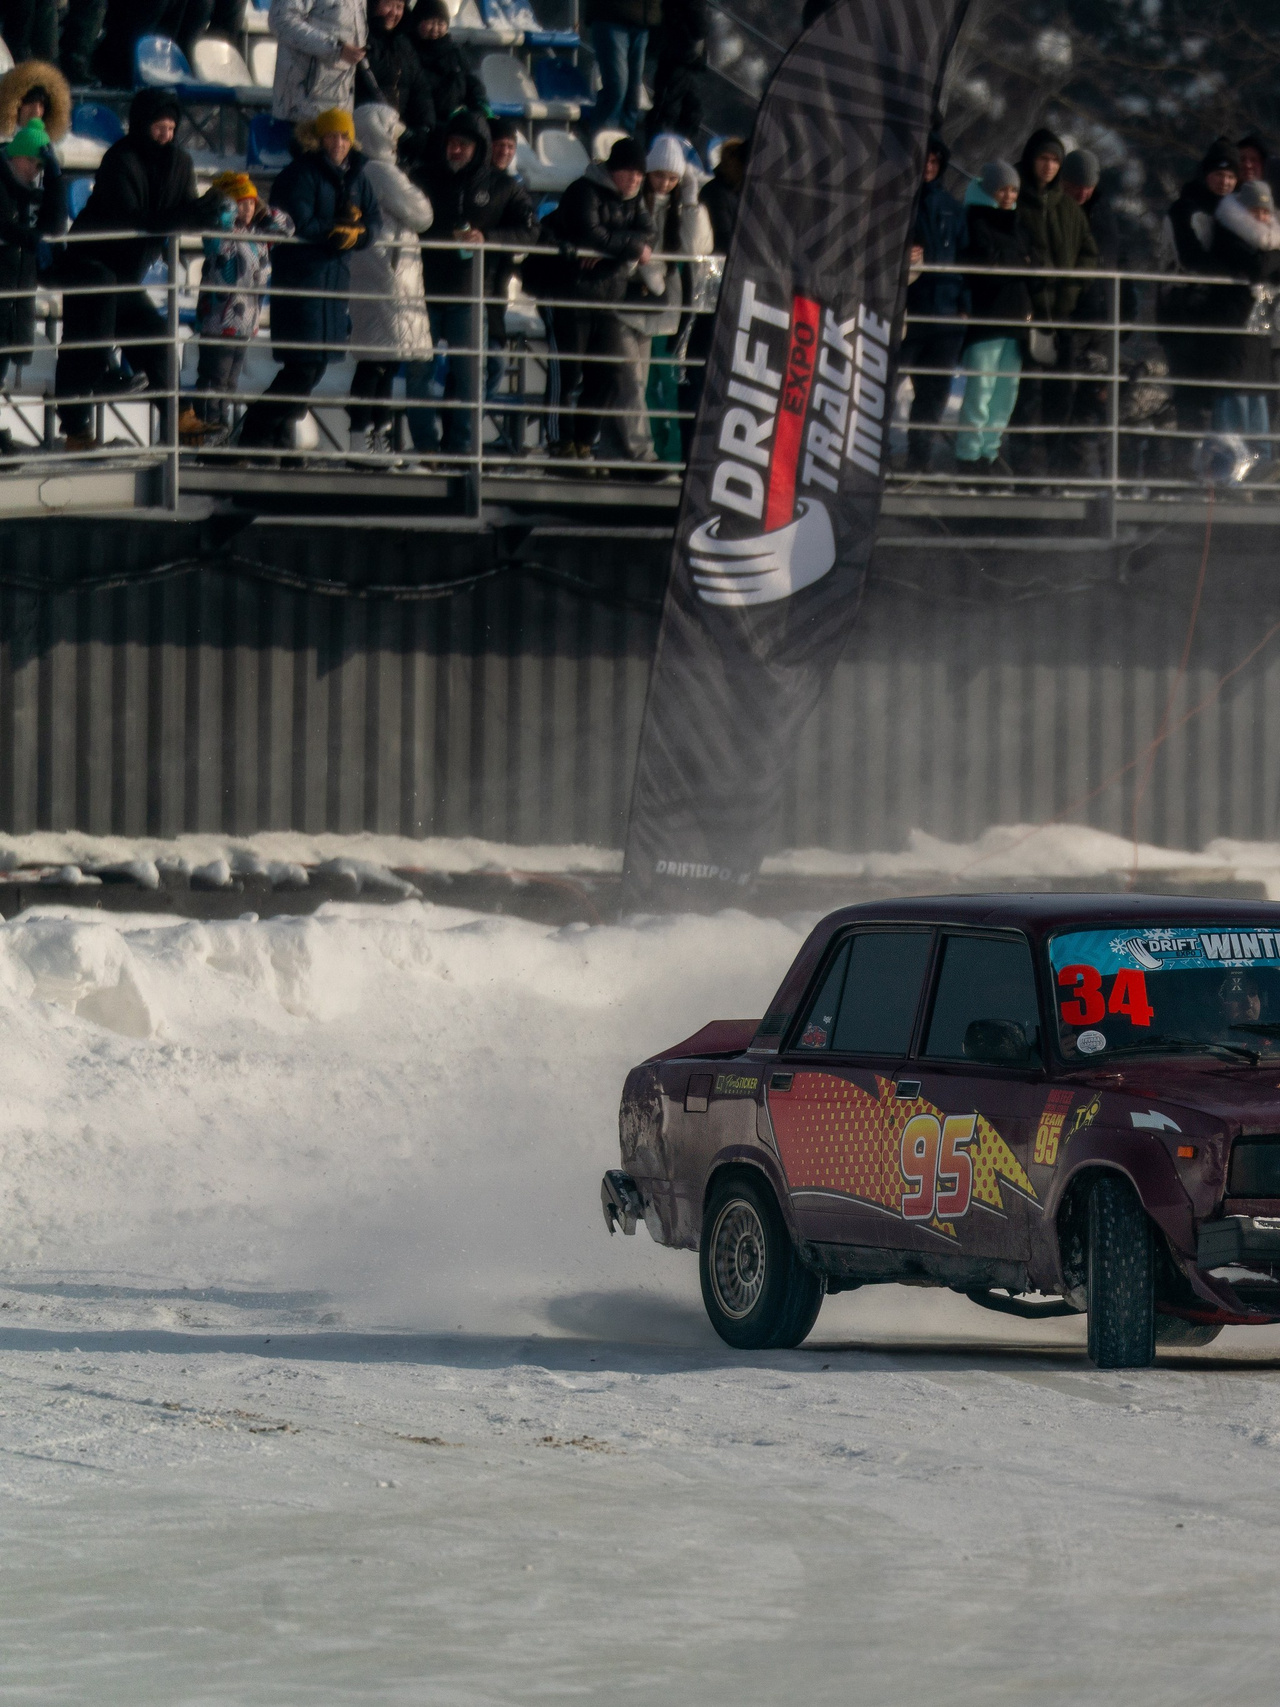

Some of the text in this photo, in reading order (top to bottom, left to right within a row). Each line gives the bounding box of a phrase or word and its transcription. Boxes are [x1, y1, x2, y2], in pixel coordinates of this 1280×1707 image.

[711, 279, 791, 521] DRIFT
[783, 321, 815, 416] EXPO
[1148, 938, 1198, 952] DRIFT
[1058, 964, 1155, 1027] 34
[1034, 1125, 1061, 1165] 95
[1040, 1112, 1066, 1127] TEAM
[901, 1113, 978, 1221] 95
